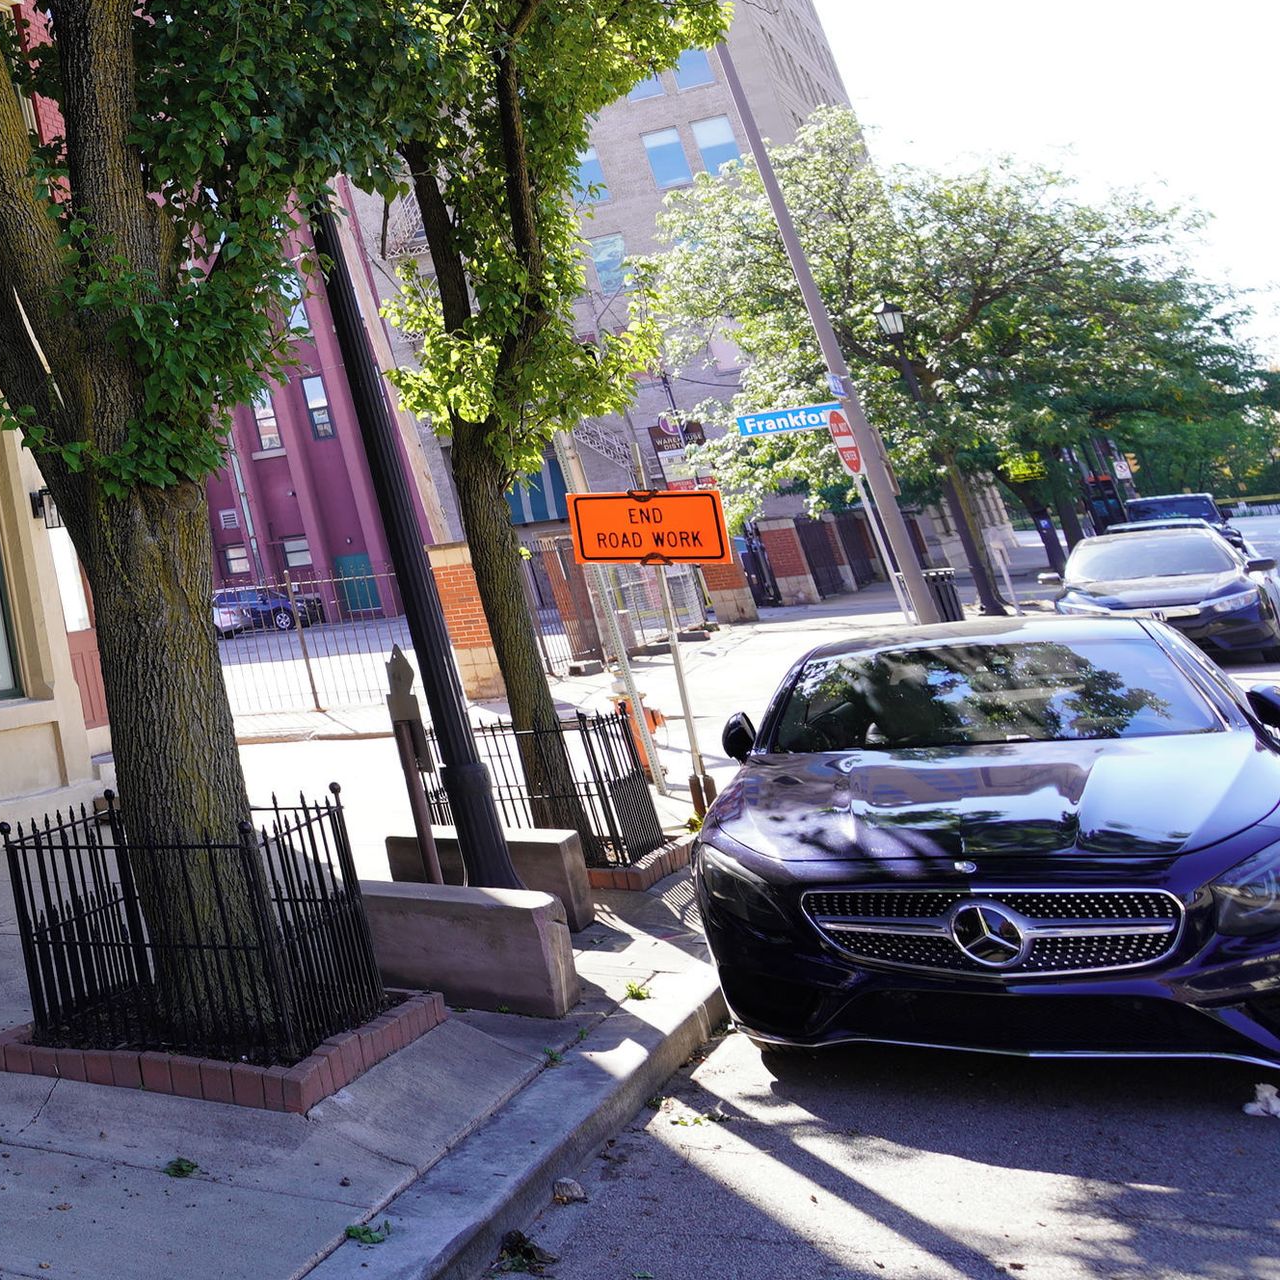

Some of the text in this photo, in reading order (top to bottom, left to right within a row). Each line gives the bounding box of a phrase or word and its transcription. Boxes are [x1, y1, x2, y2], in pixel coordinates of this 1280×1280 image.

[743, 410, 828, 433] Frankfor
[842, 450, 858, 462] ENTER
[628, 507, 663, 524] END
[596, 530, 703, 549] ROAD WORK
